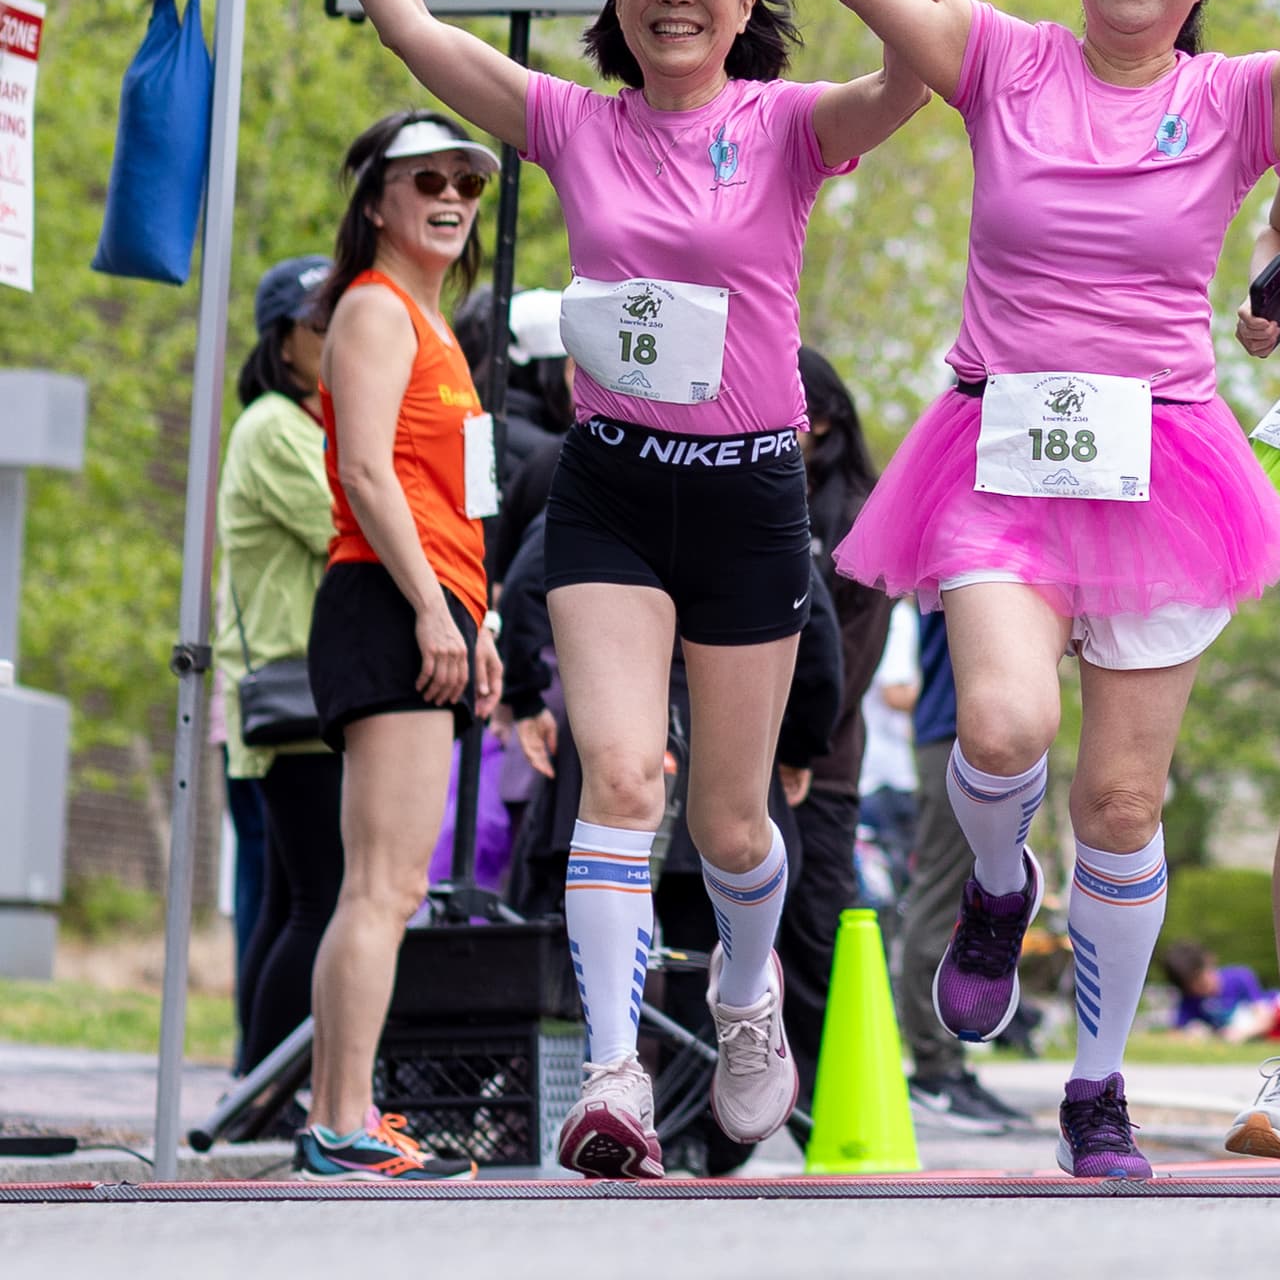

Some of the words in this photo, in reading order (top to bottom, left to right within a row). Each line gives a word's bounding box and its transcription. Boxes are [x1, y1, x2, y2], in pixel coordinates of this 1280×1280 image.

[618, 330, 658, 365] 18
[639, 436, 745, 467] NIKE
[1028, 428, 1098, 463] 188
